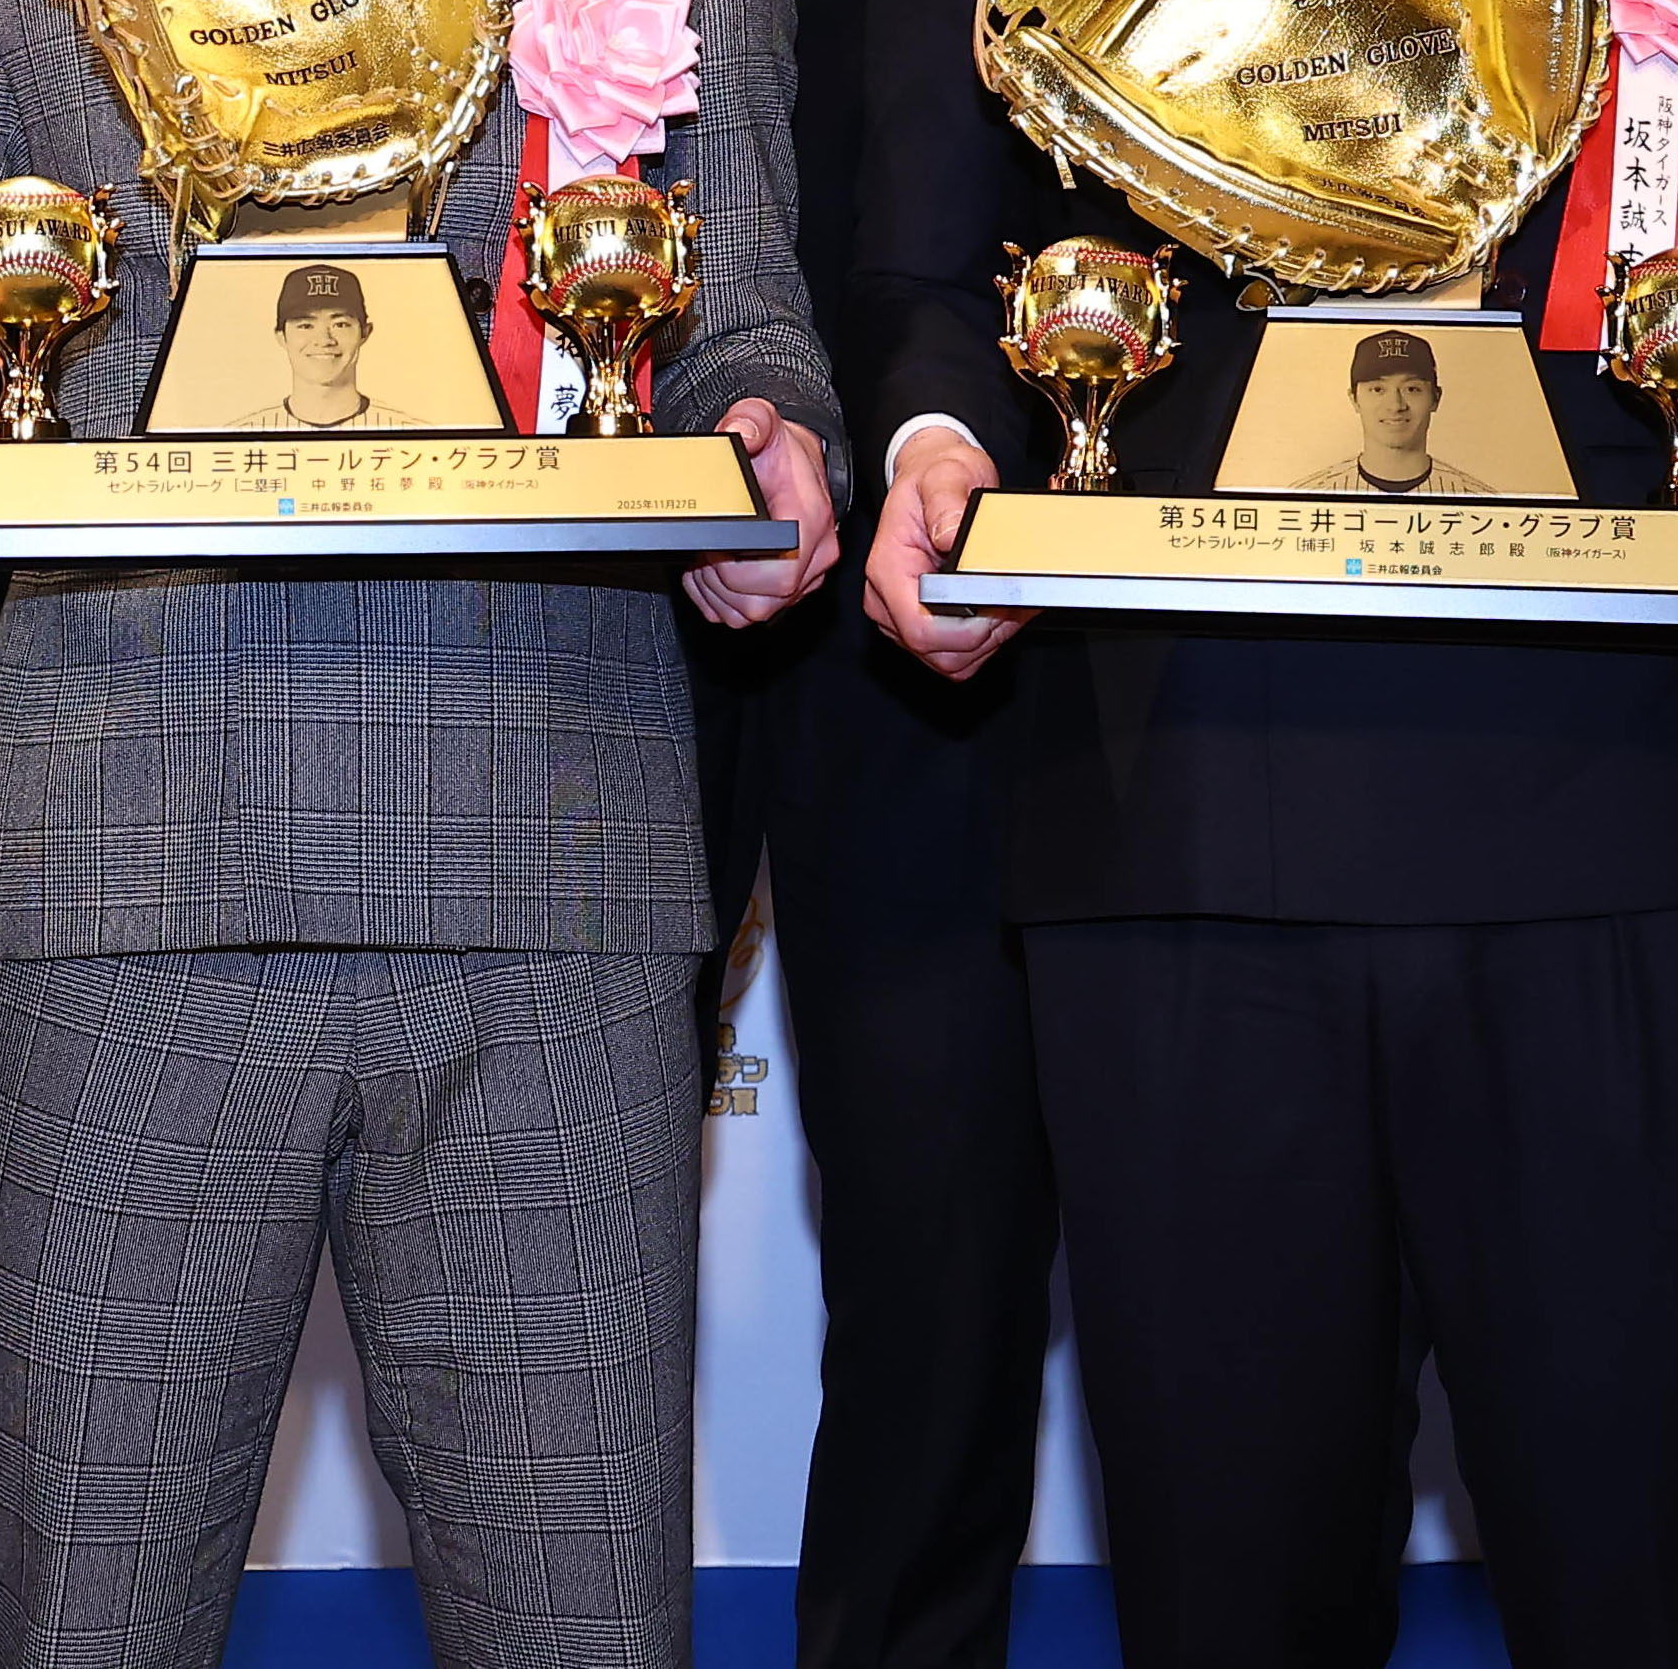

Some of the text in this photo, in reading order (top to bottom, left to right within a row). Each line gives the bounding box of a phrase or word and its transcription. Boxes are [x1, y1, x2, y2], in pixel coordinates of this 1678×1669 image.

[189, 13, 297, 46] GOLDEN
[263, 50, 359, 87] MITSUI
[1235, 30, 1457, 85] GOLDEN GLOVE
[1303, 113, 1403, 142] MITSUI
[1651, 94, 1674, 227] 阪神タイガース
[35, 217, 92, 243] AWARD
[552, 218, 617, 245] MITSUI
[1094, 276, 1154, 307] AWARD
[94, 445, 560, 475] 第54回 三井ゴールデン・グラブ賞
[107, 478, 223, 493] セントラル・リーグ
[617, 498, 697, 511] 2025年11月27日
[1159, 505, 1637, 542] 第54回 三井ゴールデン・グラブ賞
[1168, 534, 1285, 551] セントラル・リーグ
[1359, 539, 1525, 558] 坂本誠志郎殿
